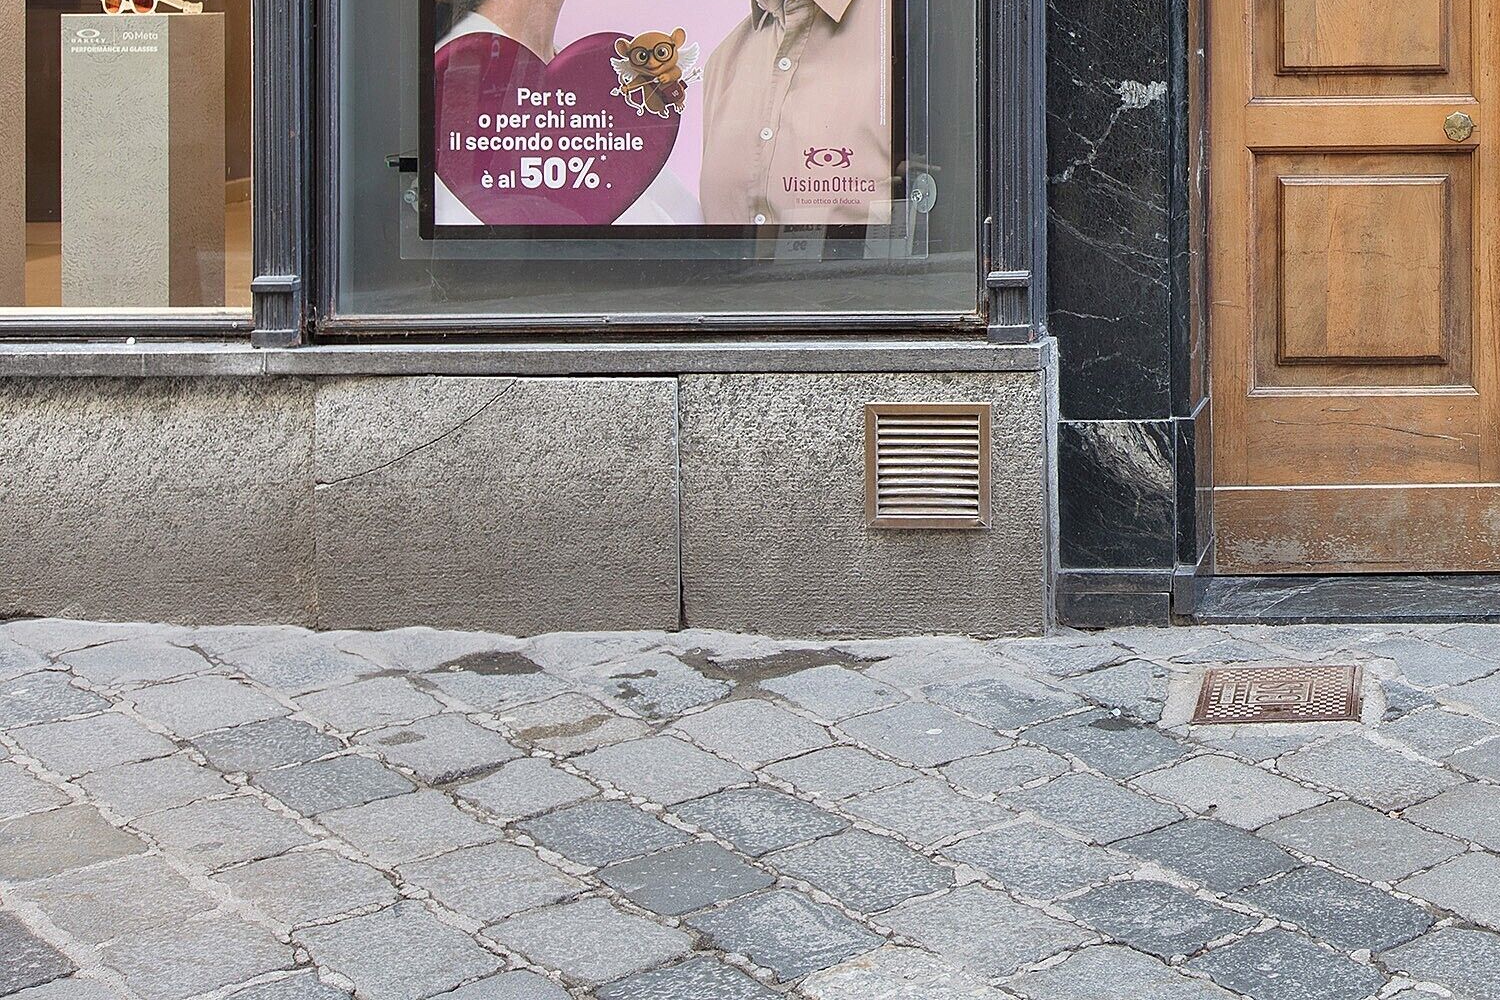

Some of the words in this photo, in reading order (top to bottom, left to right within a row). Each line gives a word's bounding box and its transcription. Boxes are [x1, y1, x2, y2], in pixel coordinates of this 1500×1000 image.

[134, 31, 159, 40] Meta
[517, 87, 551, 106] Per
[556, 88, 577, 106] te
[478, 113, 491, 128] o
[496, 113, 531, 133] per
[535, 110, 565, 128] chi
[569, 110, 614, 129] ami:
[450, 132, 461, 150] il
[465, 132, 553, 151] secondo
[558, 132, 644, 151] occhiale
[481, 170, 494, 188] è
[497, 170, 516, 188] al
[783, 176, 876, 192] VisionOttica
[832, 197, 839, 205] di
